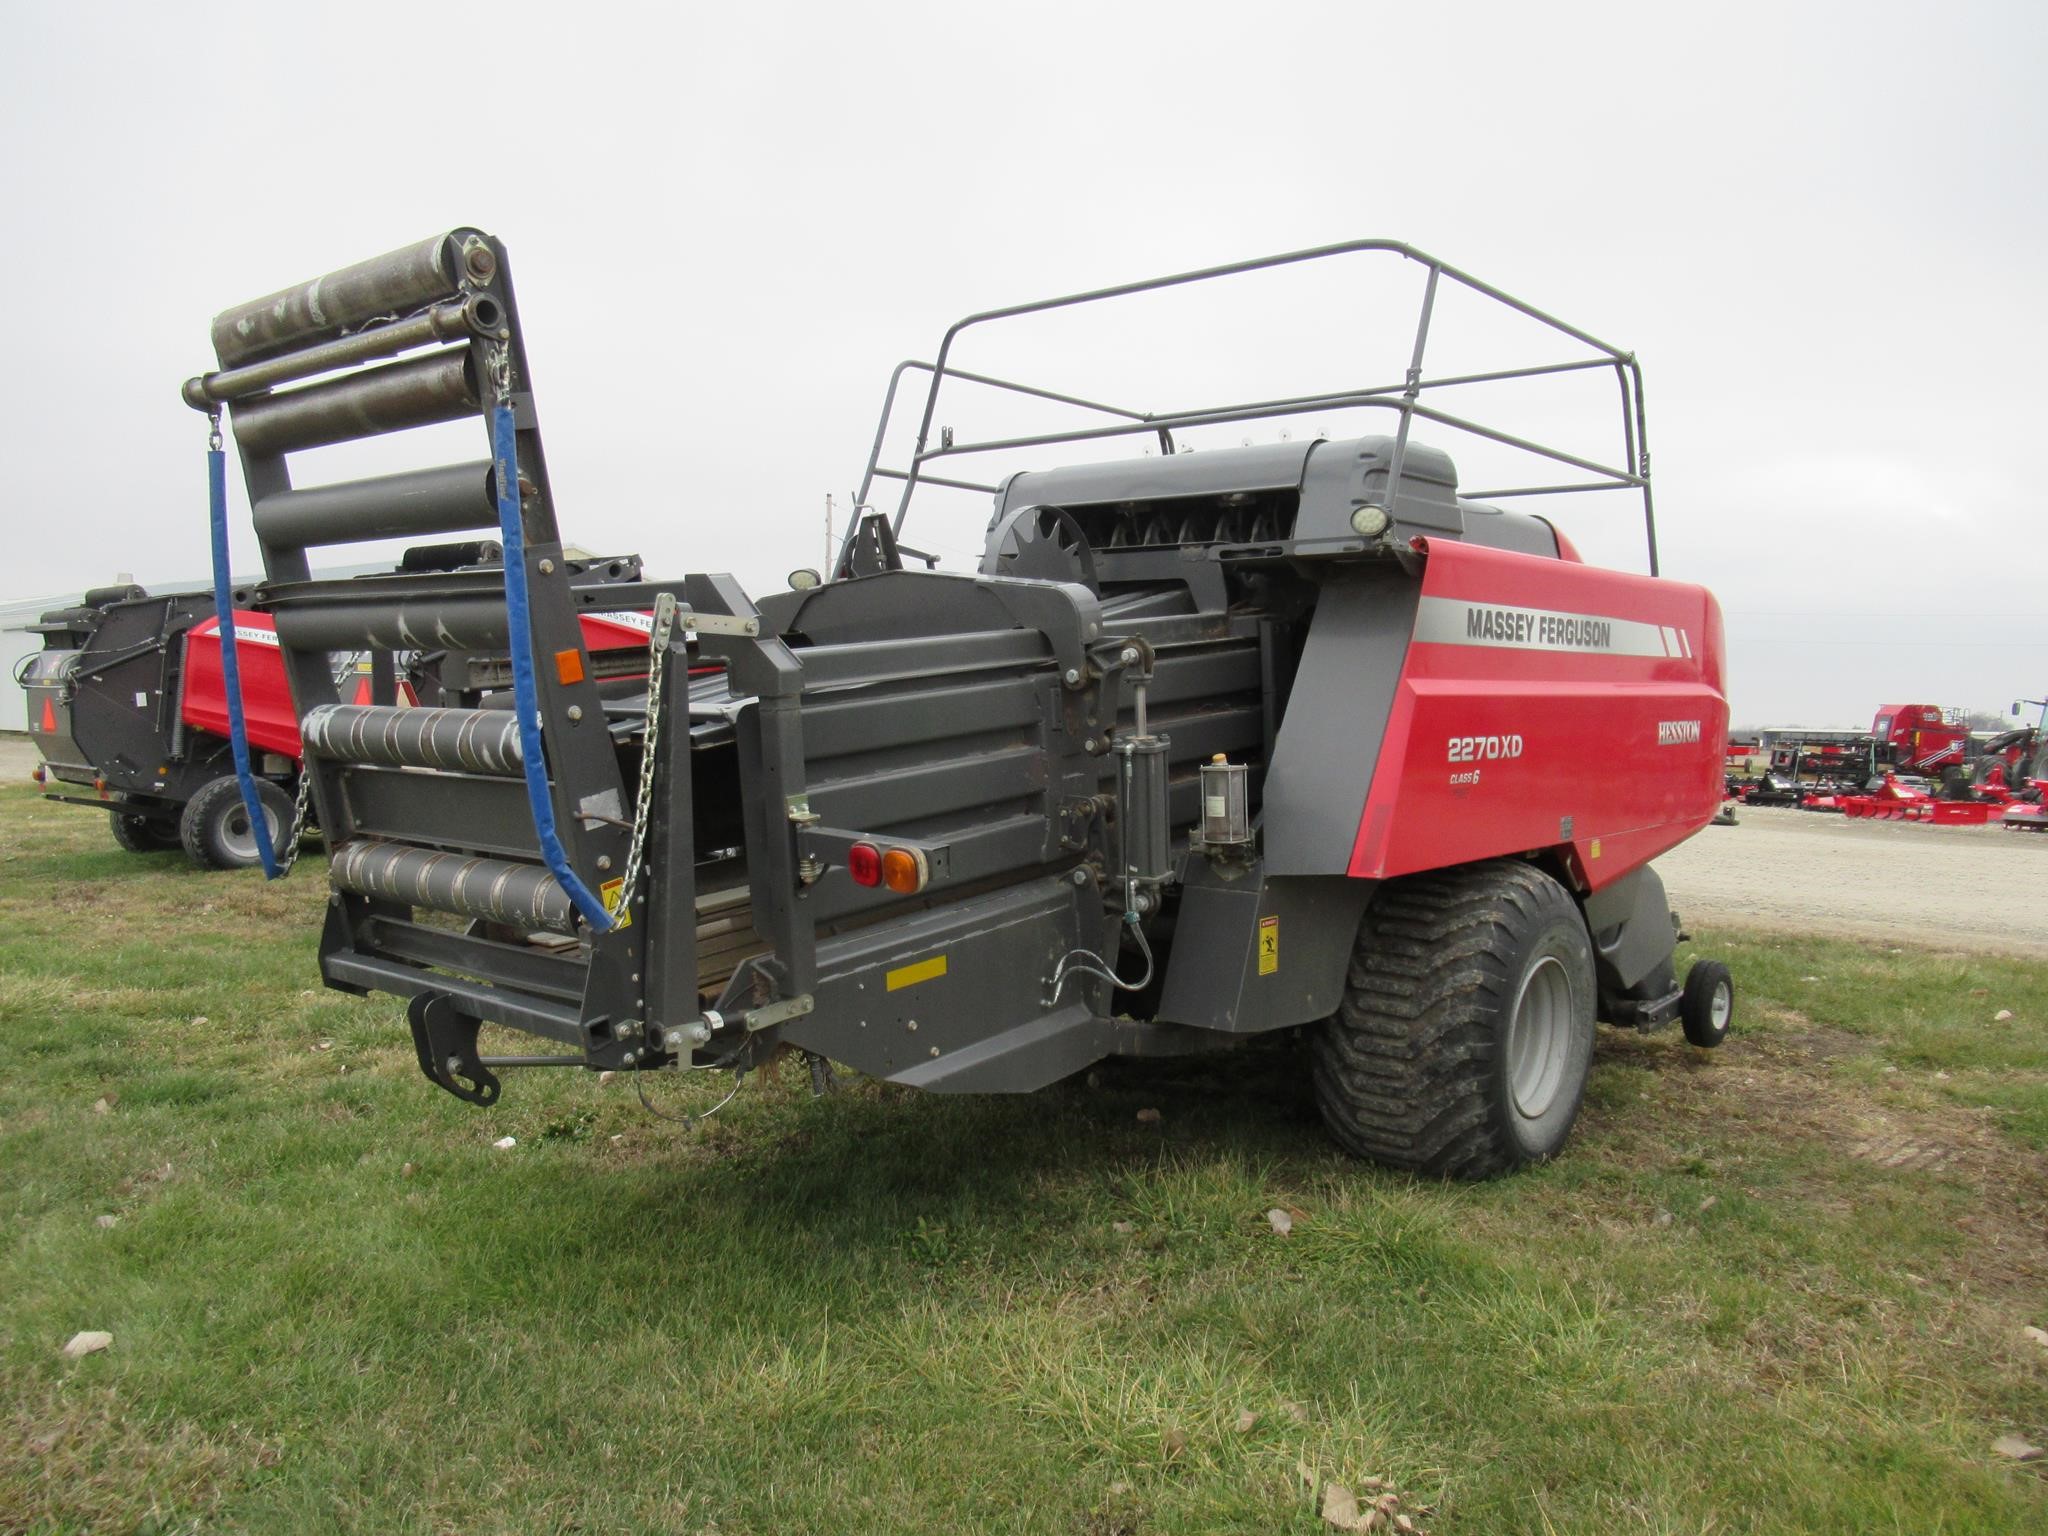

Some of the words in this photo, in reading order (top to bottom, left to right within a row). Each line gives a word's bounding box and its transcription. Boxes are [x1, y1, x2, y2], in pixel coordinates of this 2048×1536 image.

[1467, 608, 1534, 642] MASSEY
[1539, 616, 1610, 647] FERGUSON
[1658, 720, 1700, 745] HESSTON
